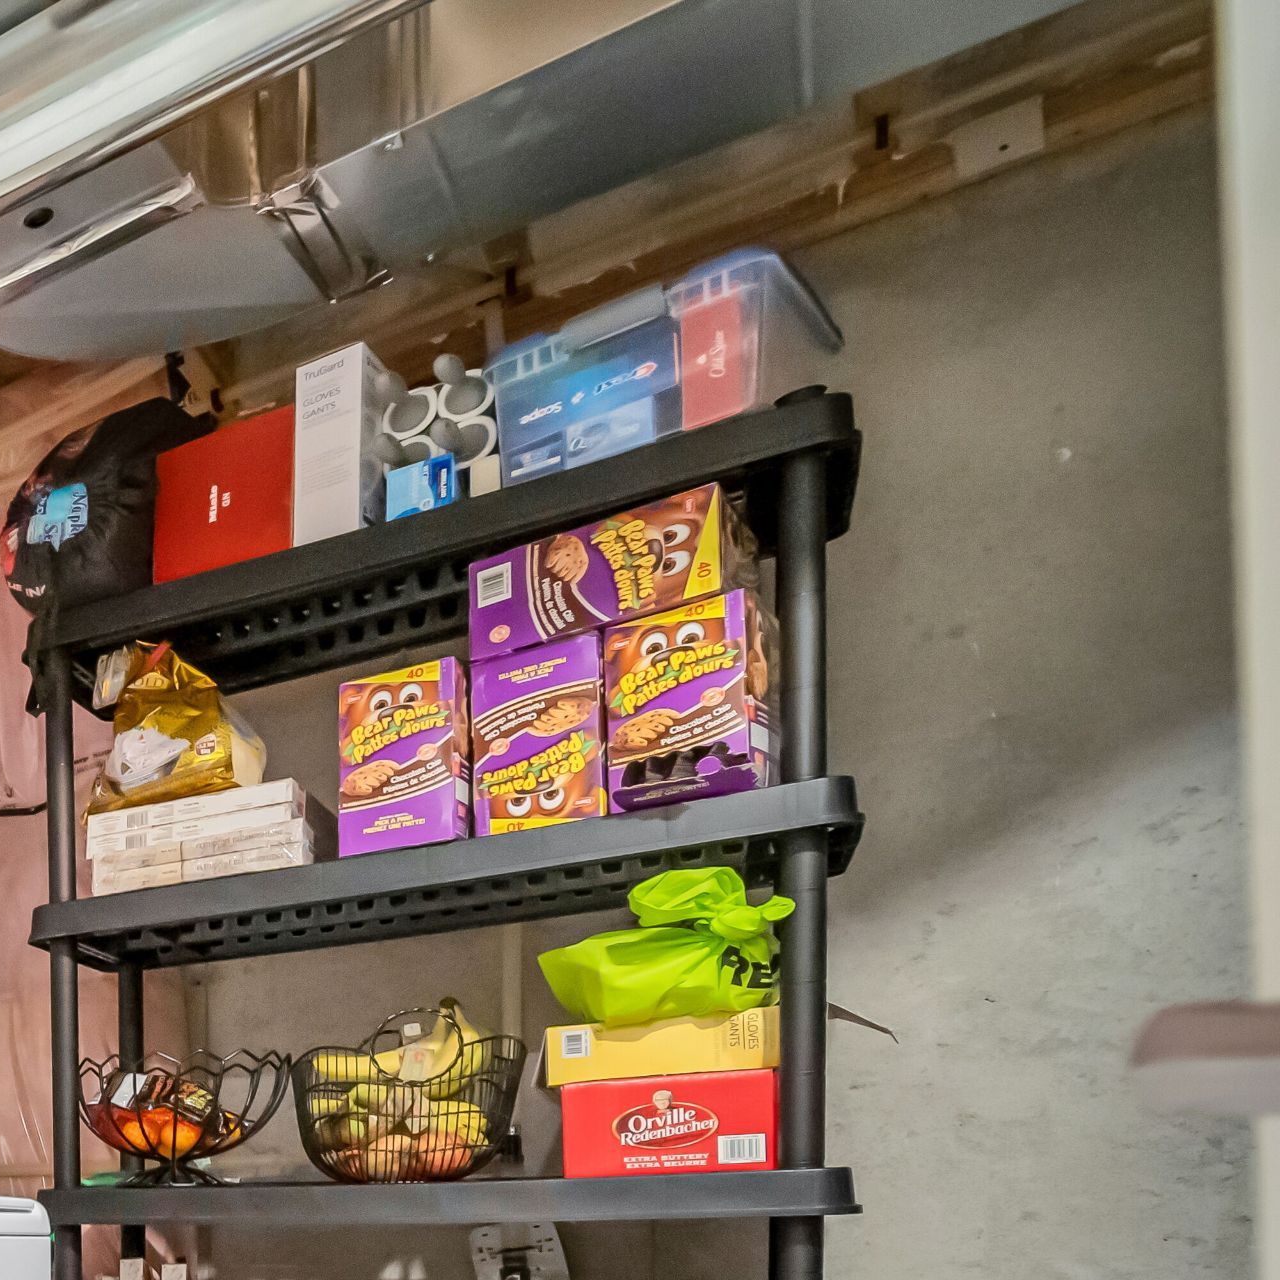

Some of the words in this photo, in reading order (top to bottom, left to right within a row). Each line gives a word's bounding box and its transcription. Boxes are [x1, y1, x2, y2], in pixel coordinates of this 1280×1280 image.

[303, 359, 345, 382] TruGard
[302, 386, 342, 408] GLOVES
[302, 402, 337, 420] GANTS
[591, 529, 627, 576] Pattes
[619, 519, 649, 556] Bear
[635, 554, 657, 600] Paws
[696, 561, 712, 579] 40
[684, 604, 705, 618] 40
[406, 668, 424, 679] 40
[619, 660, 669, 695] Bear
[669, 642, 726, 671] Paws
[623, 678, 678, 715] Pattes
[351, 715, 392, 745] Bear
[393, 703, 439, 724] Paws
[669, 709, 712, 734] Chocolate
[713, 702, 732, 716] Chip
[352, 731, 399, 764] Pattes
[530, 732, 583, 766] Pattes
[539, 752, 586, 782] Bear
[490, 774, 537, 797] Paws
[747, 1012, 759, 1050] GLOVES
[620, 1117, 716, 1147] Redenbacher
[627, 1107, 697, 1134] Orville
[623, 1155, 657, 1163] EXTRA
[661, 1153, 709, 1161] BUTTERY
[626, 1161, 660, 1169] EXTRA
[663, 1159, 707, 1167] BEURRE
